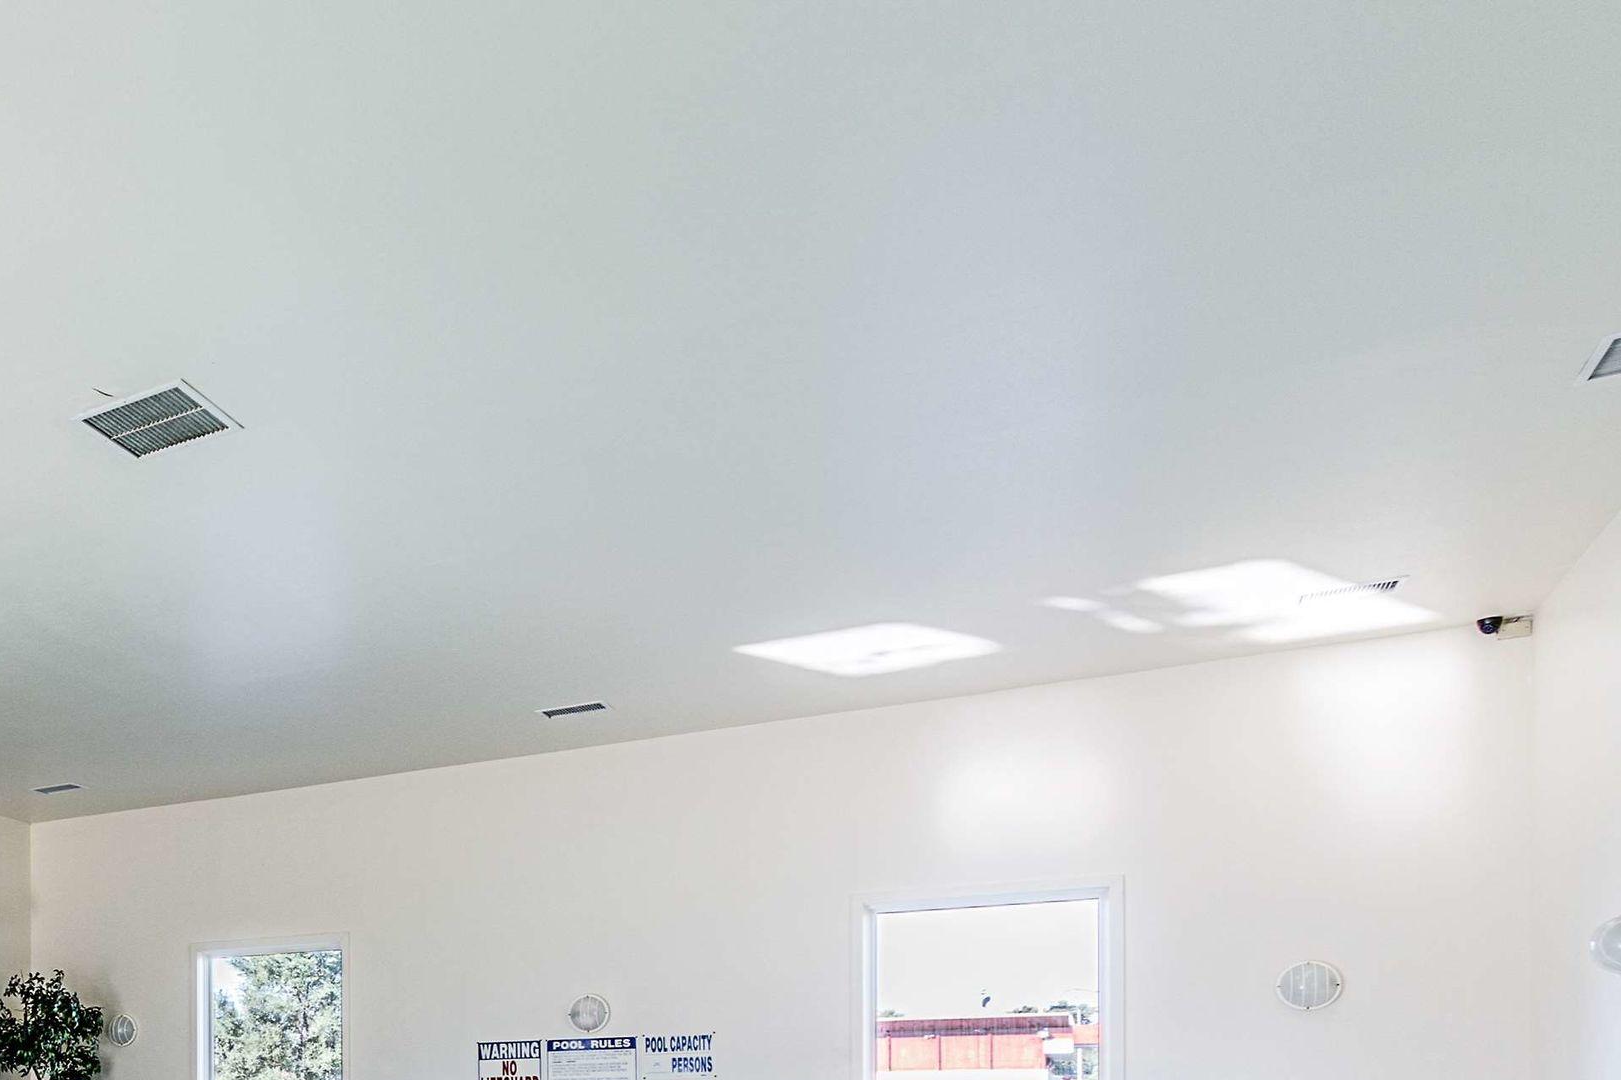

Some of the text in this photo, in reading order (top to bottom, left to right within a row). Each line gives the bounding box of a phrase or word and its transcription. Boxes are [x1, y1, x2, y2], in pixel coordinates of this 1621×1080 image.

[480, 1042, 540, 1059] WARNING
[552, 1039, 631, 1050] POOL RULES
[645, 1035, 712, 1053] POOL CAPACITY
[502, 1060, 517, 1076] NO
[672, 1056, 713, 1072] PERSONS
